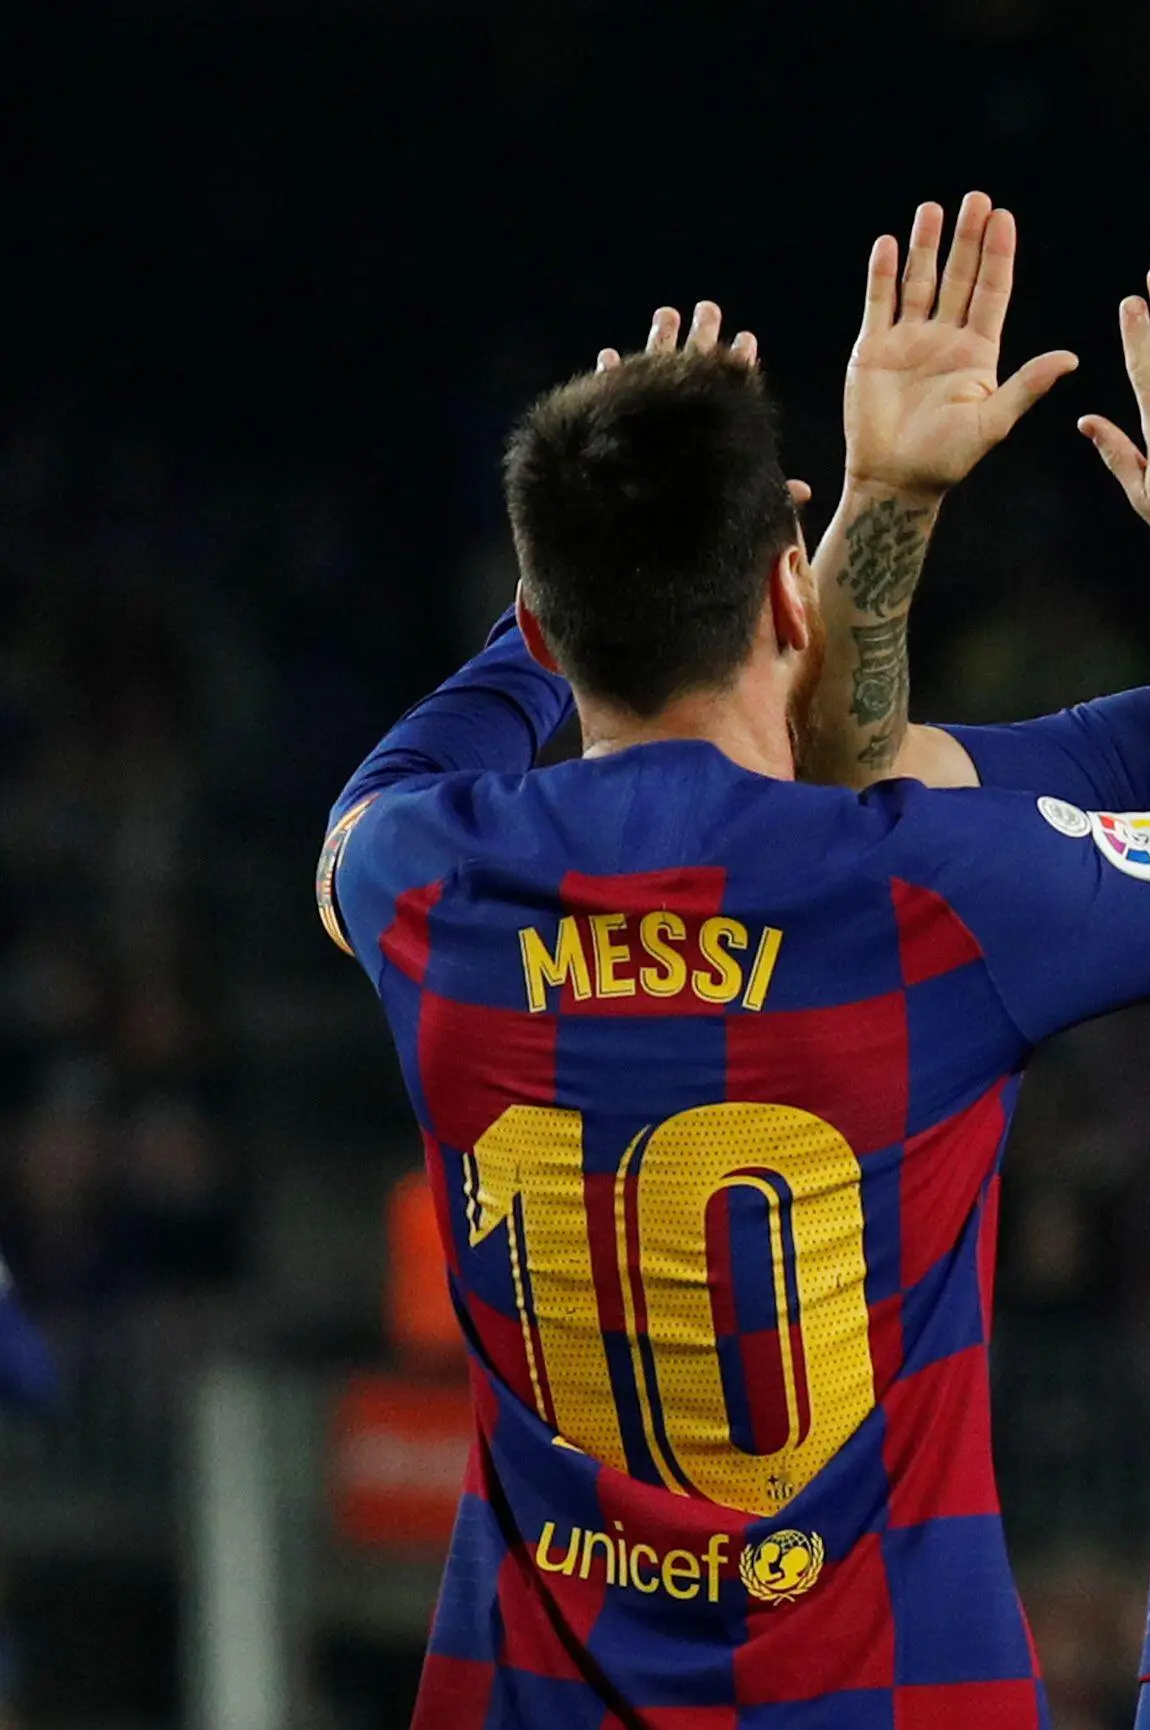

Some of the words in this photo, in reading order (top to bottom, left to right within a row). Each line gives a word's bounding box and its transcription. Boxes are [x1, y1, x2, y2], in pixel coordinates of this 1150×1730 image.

[518, 909, 783, 1013] MESSI
[463, 1102, 876, 1517] 10
[535, 1521, 730, 1602] unicef
